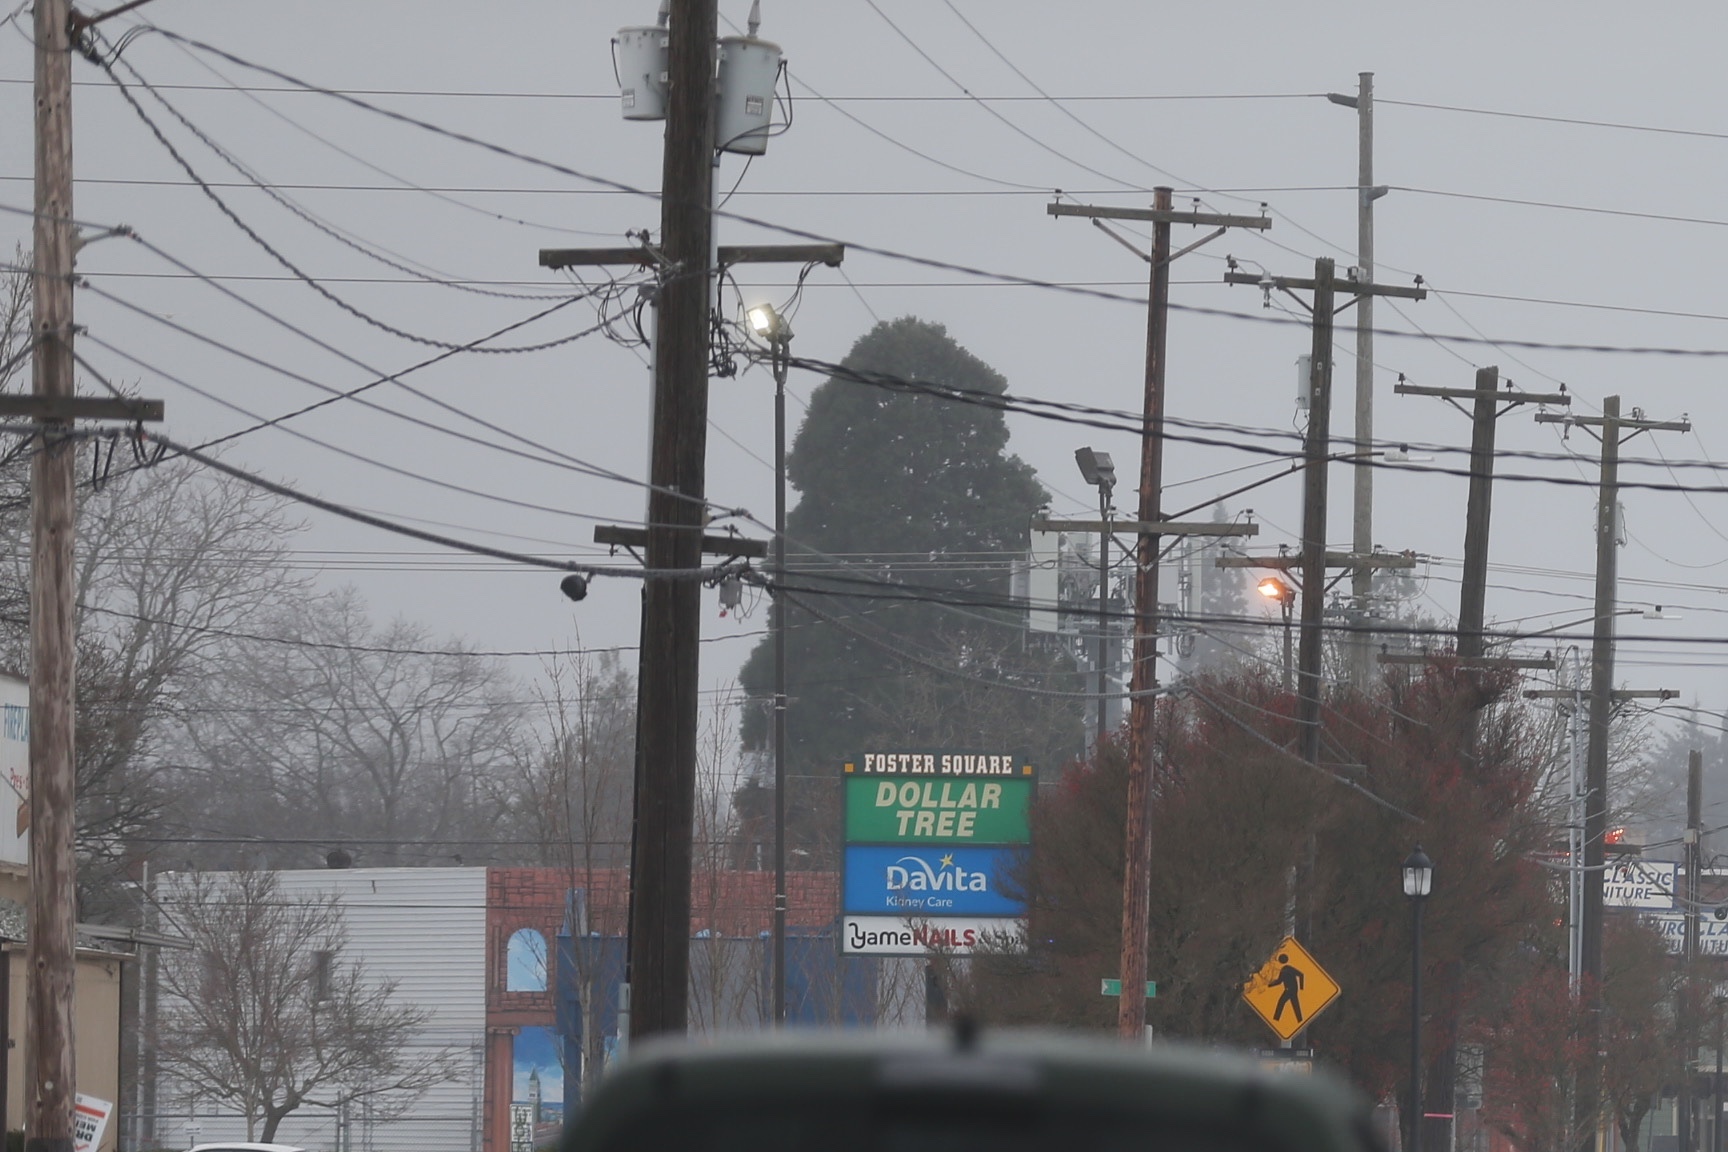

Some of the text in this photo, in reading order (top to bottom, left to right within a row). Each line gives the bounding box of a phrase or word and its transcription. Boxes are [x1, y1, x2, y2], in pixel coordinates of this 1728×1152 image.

[864, 754, 1013, 776] FOSTER SQUARE
[875, 781, 1002, 808] DOLLAR
[896, 810, 977, 837] TREE
[886, 896, 953, 909] Kidney Care
